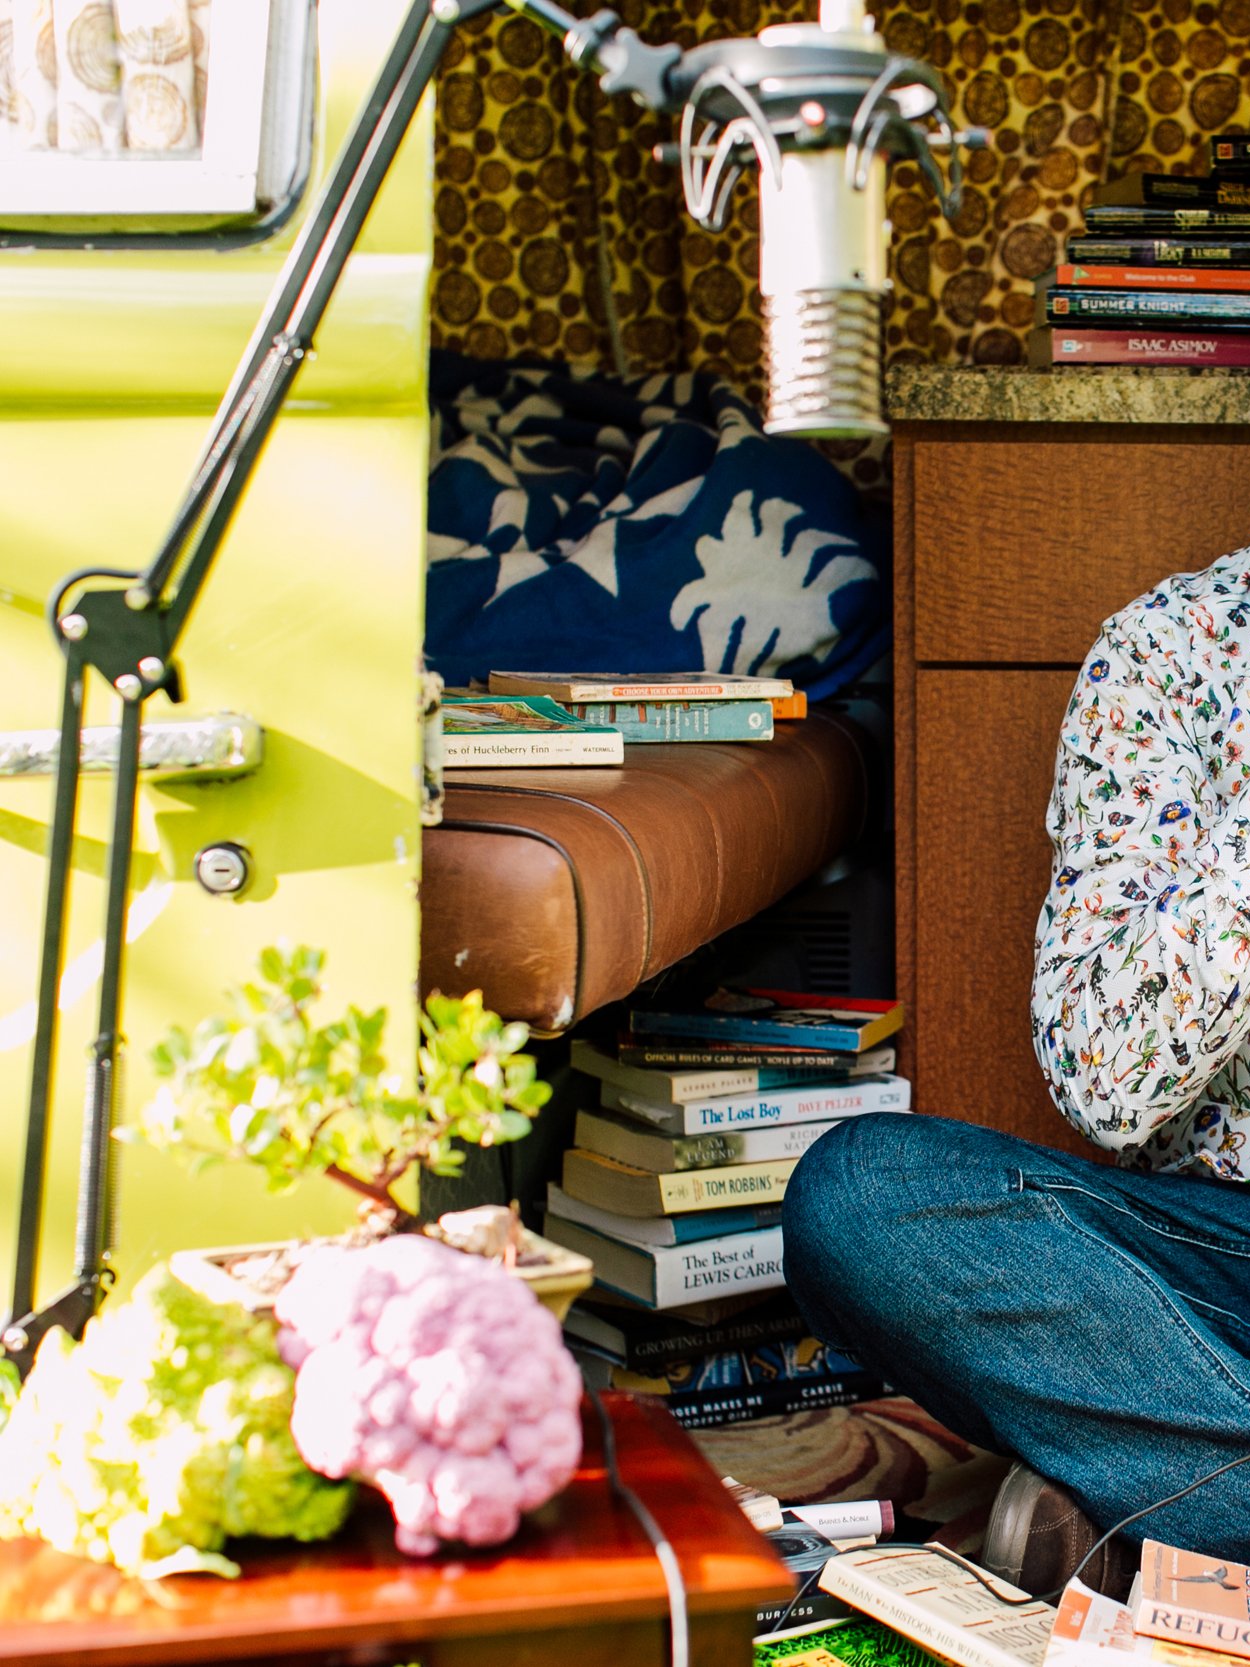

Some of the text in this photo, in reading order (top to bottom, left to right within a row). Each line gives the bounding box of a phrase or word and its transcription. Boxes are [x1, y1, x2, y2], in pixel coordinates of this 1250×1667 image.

[1081, 298, 1186, 312] SUMMER KNIGHT
[1127, 339, 1218, 353] ISAAC ASIMOV
[622, 687, 649, 696] CHOOSE
[650, 687, 666, 696] YOUR
[667, 687, 683, 695] OWN
[683, 686, 720, 695] ADVENTURE
[461, 745, 471, 755] of
[473, 745, 528, 756] Huckleberry
[531, 745, 550, 754] Finn
[644, 1053, 676, 1063] OFFICIAL
[678, 1053, 700, 1063] RULES
[701, 1053, 712, 1064] OF
[714, 1054, 735, 1065] CARD
[737, 1055, 762, 1065] GAMES
[804, 1056, 815, 1066] TO
[700, 1096, 863, 1126] The Lost Boy DAVE PELZER
[708, 1139, 725, 1150] AM
[686, 1148, 736, 1164] LEGEND
[705, 1179, 726, 1196] TOM
[728, 1175, 773, 1195] ROBBINS
[682, 1245, 755, 1271] The Best of
[683, 1268, 731, 1290] LEWIS
[634, 1322, 764, 1357] GROWING THEN
[801, 1382, 843, 1398] CARRIE
[702, 1395, 763, 1413] MAKES ME
[786, 1393, 859, 1411] BROWNSTEIN
[727, 1409, 754, 1422] GIRL
[818, 1514, 870, 1527] BARNES & NOBLE
[756, 1606, 814, 1622] BURESS
[850, 1583, 873, 1602] MAN
[889, 1604, 934, 1638] MISTOOK
[935, 1631, 955, 1648] HIS
[956, 1642, 981, 1663] WIFE
[976, 1618, 1056, 1650] MISTOO
